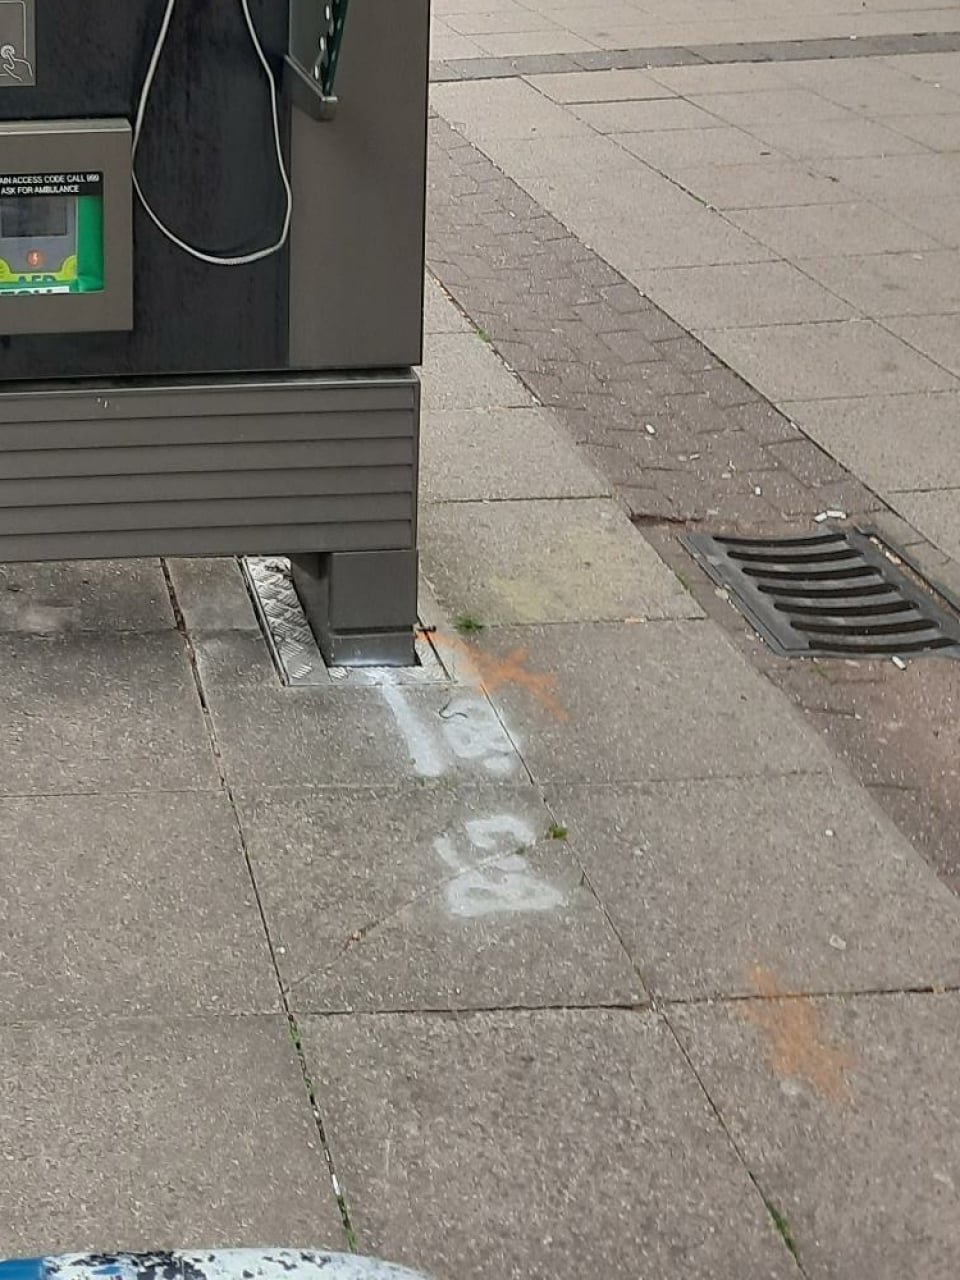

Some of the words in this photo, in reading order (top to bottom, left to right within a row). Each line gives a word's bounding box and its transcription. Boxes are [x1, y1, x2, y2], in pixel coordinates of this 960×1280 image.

[13, 176, 42, 184] ACCESS
[44, 176, 65, 184] CODE
[67, 175, 86, 183] CALL
[1, 187, 16, 195] ASK
[17, 186, 33, 195] FOR
[34, 185, 80, 194] AMBULANCE
